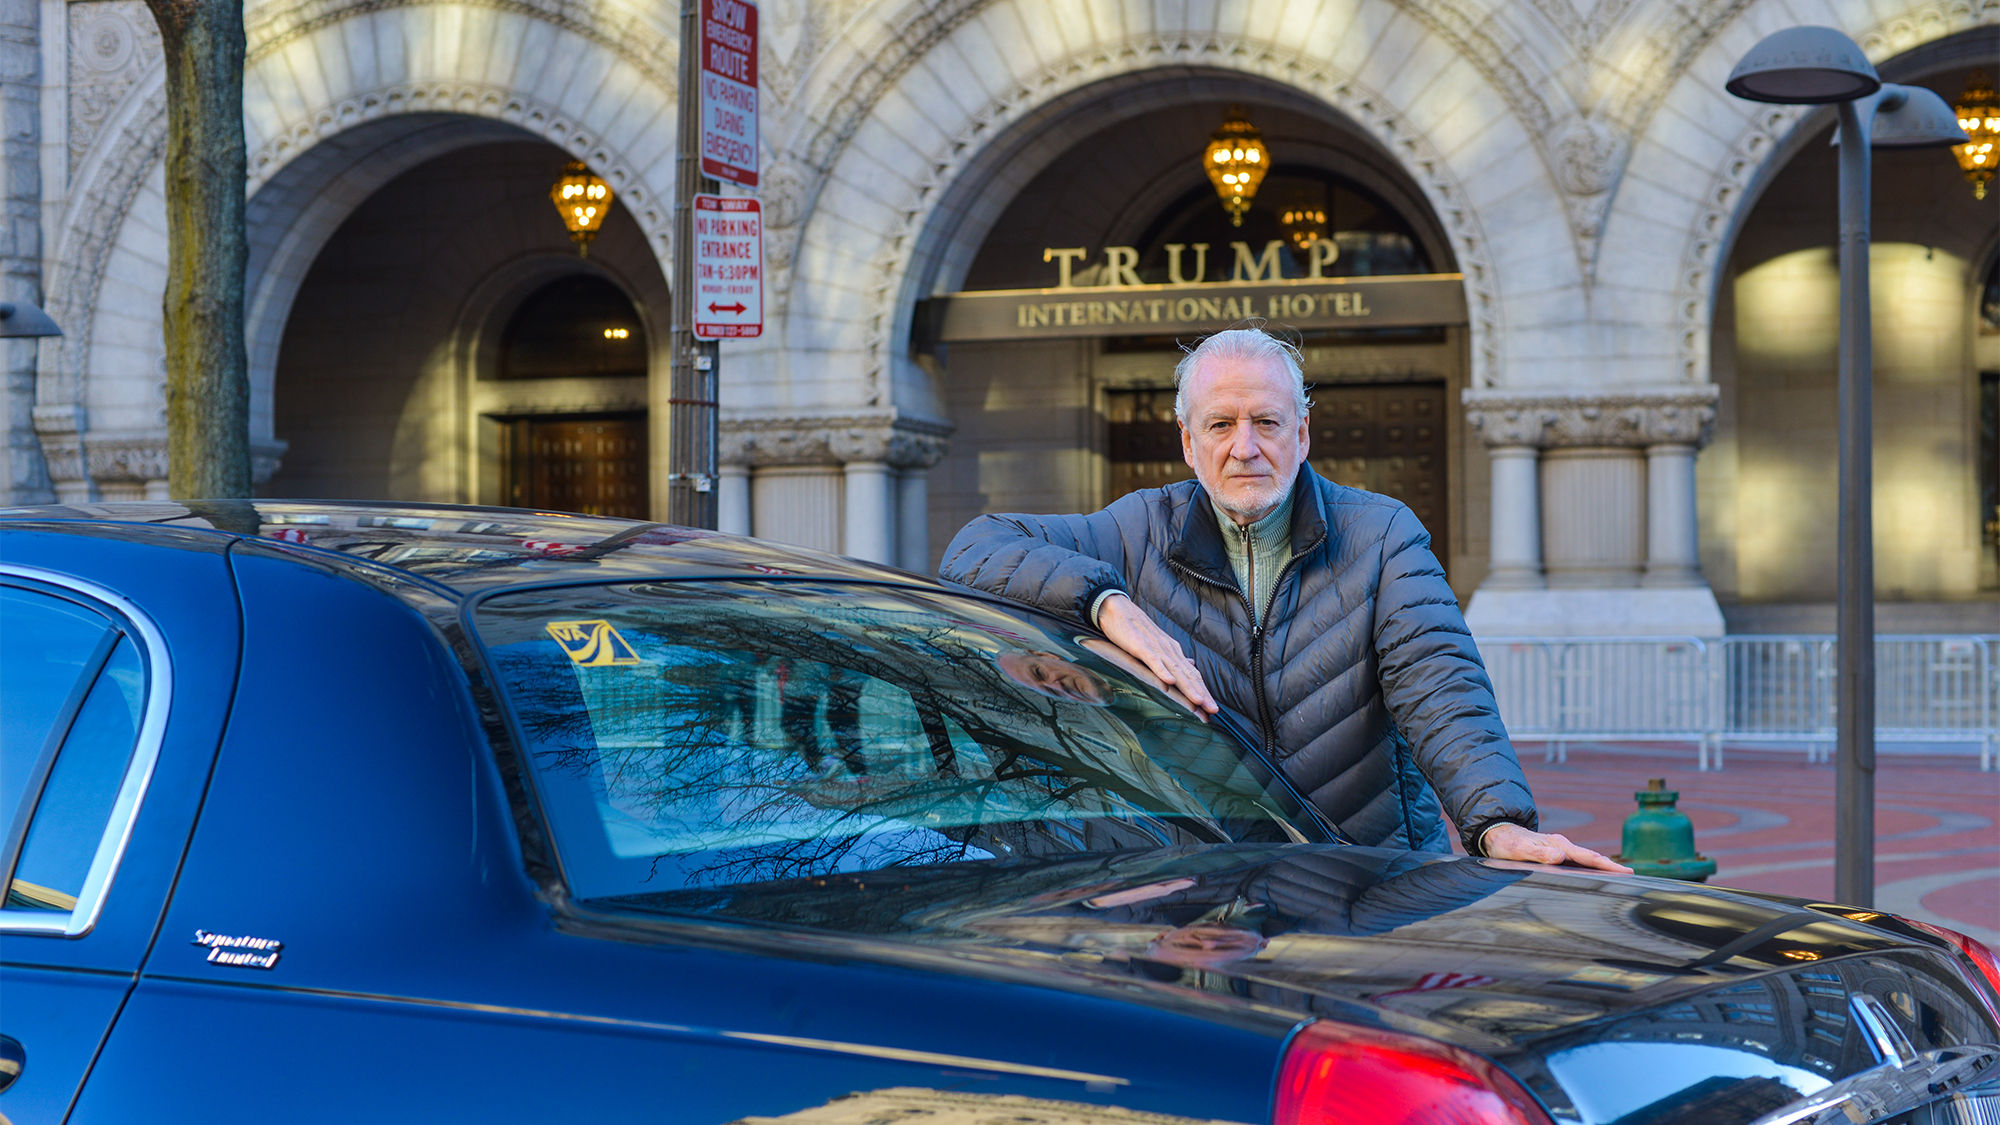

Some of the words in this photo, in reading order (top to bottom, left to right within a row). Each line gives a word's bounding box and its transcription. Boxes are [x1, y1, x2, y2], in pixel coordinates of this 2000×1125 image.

[712, 0, 747, 30] SNOW
[706, 19, 752, 53] EMERGENCY
[711, 43, 748, 80] ROUTE
[706, 77, 718, 100] NO
[720, 82, 753, 112] PARKING
[715, 107, 744, 136] DURING
[707, 131, 753, 165] EMERGENCY
[698, 218, 707, 234] NO
[711, 218, 757, 237] PARKING
[702, 240, 751, 259] ENTRANCE
[1043, 239, 1340, 288] TRUMP
[1017, 297, 1259, 327] INTERNATIONAL
[1269, 293, 1371, 318] HOTEL
[552, 627, 591, 641] VA
